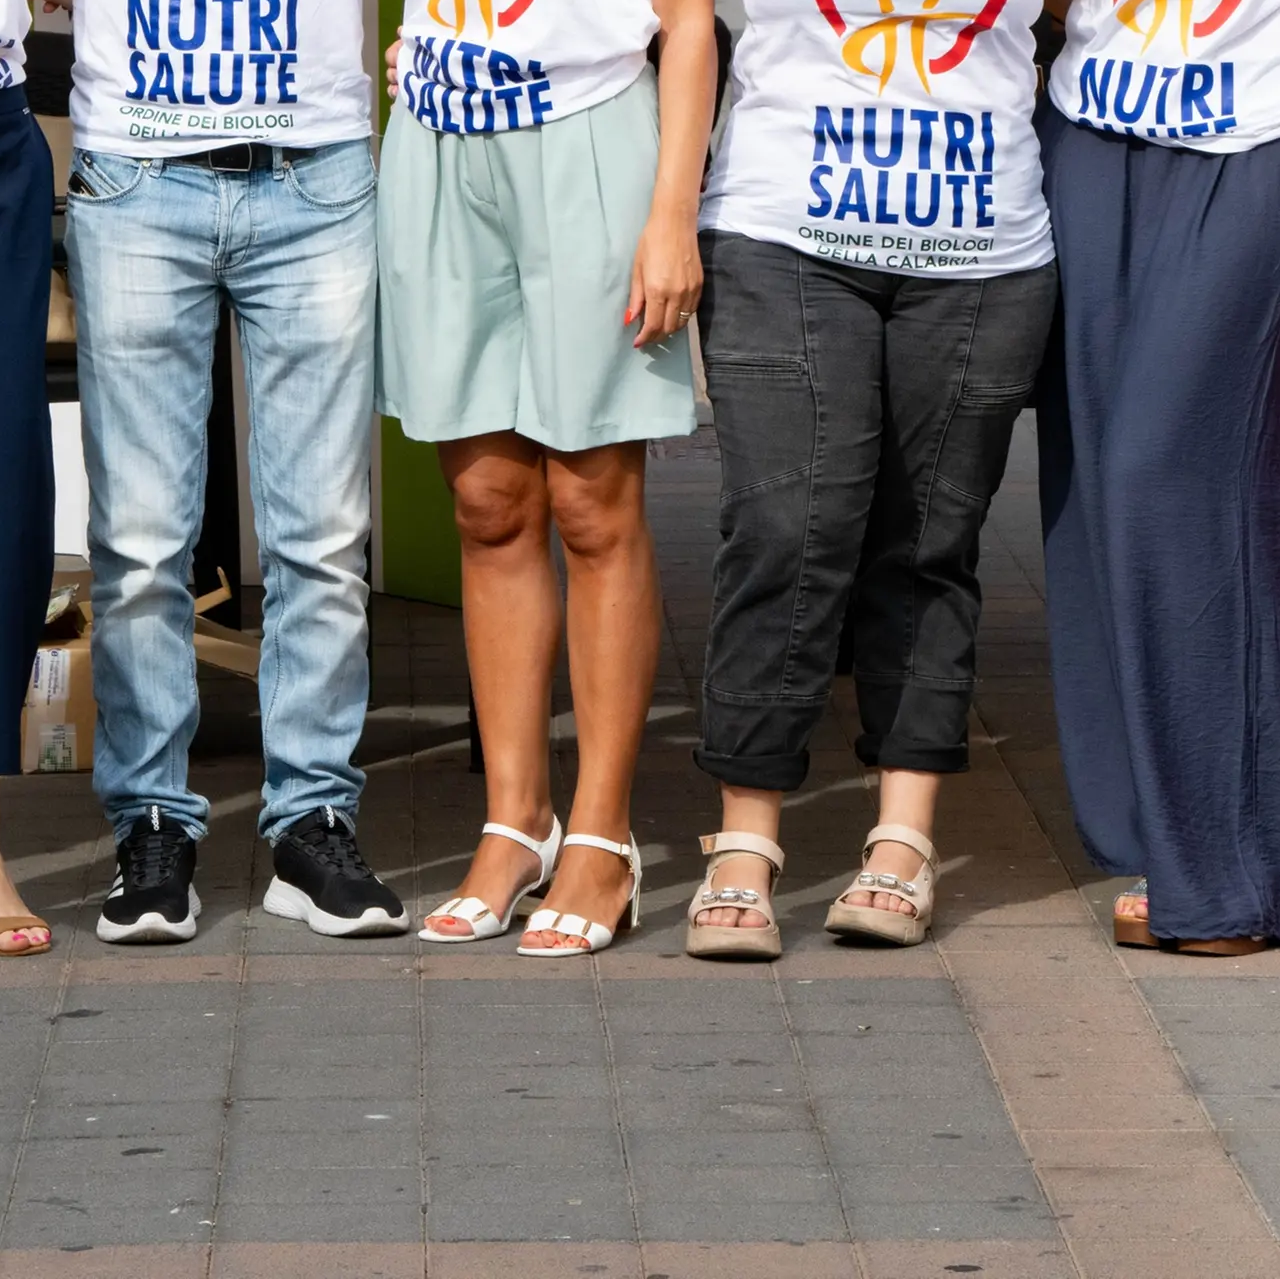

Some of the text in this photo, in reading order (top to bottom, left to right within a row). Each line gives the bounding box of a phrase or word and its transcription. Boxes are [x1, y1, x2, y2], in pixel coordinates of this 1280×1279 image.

[125, 51, 298, 105] SALUTE
[403, 71, 553, 133] SALUTE
[1078, 58, 1234, 125] NUTRI
[120, 106, 294, 130] ORDINE DEI BIOLOGI
[813, 106, 995, 172] NUTRI
[808, 164, 995, 228] SALUTE
[798, 227, 994, 252] ORDINE DEI BIOLOGI
[817, 245, 979, 269] DELLA CALABRIA
